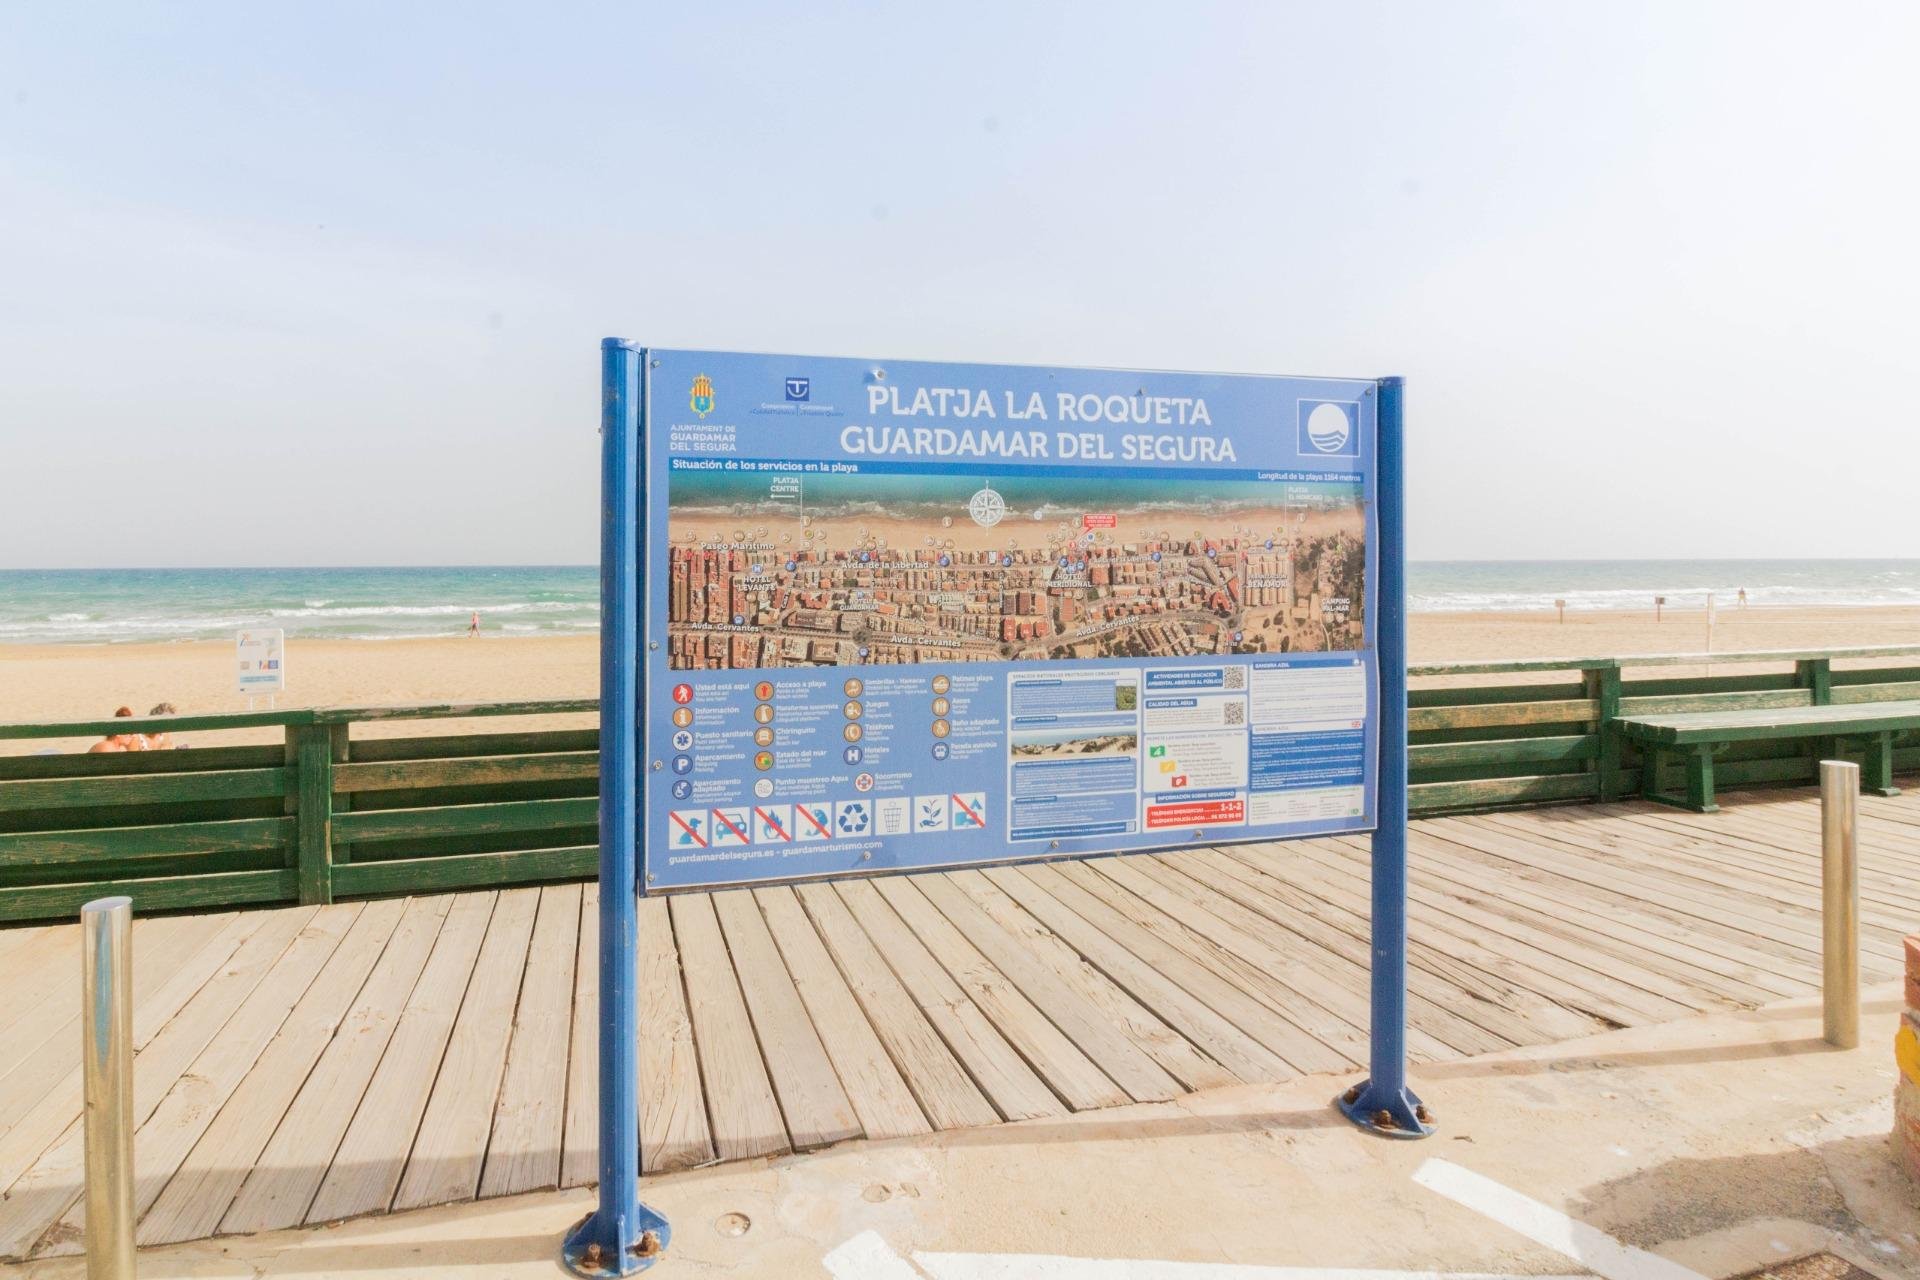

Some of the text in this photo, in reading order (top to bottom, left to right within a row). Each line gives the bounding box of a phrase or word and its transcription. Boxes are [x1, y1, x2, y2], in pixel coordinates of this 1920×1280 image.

[867, 384, 1212, 426] PLATJA LA ROQUETA
[670, 424, 722, 432] AJUNTAMENT
[670, 432, 736, 442] GUARDAMAR
[670, 442, 736, 452] DEL SEGURA
[840, 426, 1237, 463] GUARDAMAR DEL SEGURA
[672, 459, 722, 469] Situación
[725, 461, 738, 470] de
[741, 460, 756, 470] los
[758, 462, 802, 472] servicios
[820, 462, 830, 472] la
[832, 463, 858, 473] playa
[668, 850, 774, 864] guardamardelsegura.es
[782, 840, 883, 856] guardamarturismo.com
